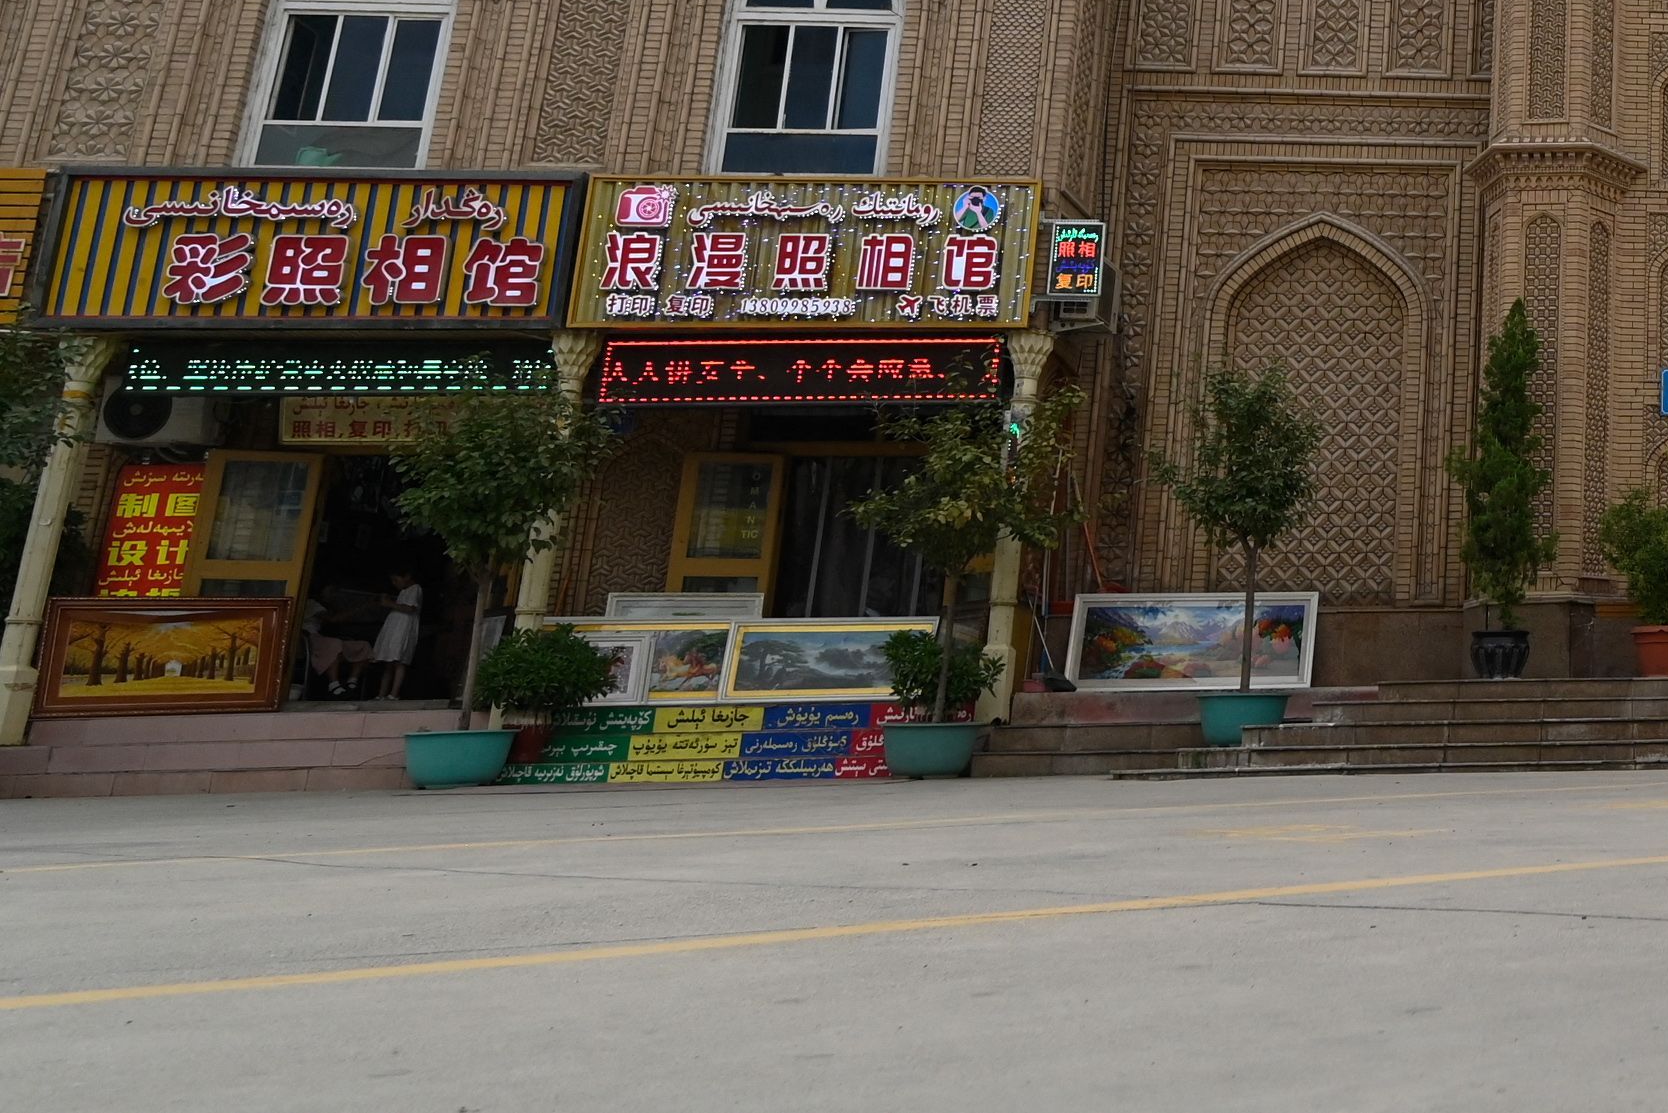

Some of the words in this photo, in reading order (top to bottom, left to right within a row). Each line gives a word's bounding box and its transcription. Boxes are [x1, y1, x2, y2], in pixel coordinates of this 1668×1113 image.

[1058, 240, 1097, 258] 照相
[162, 232, 544, 307] 彩照相馆
[598, 231, 998, 290] 浪漫照相馆
[1055, 272, 1094, 289] 复印
[606, 294, 652, 316] 打印
[664, 295, 713, 316] 复印
[740, 297, 853, 315] 13809985938
[927, 294, 998, 316] 飞机票
[115, 492, 201, 518] 制图
[107, 539, 189, 566] 设计
